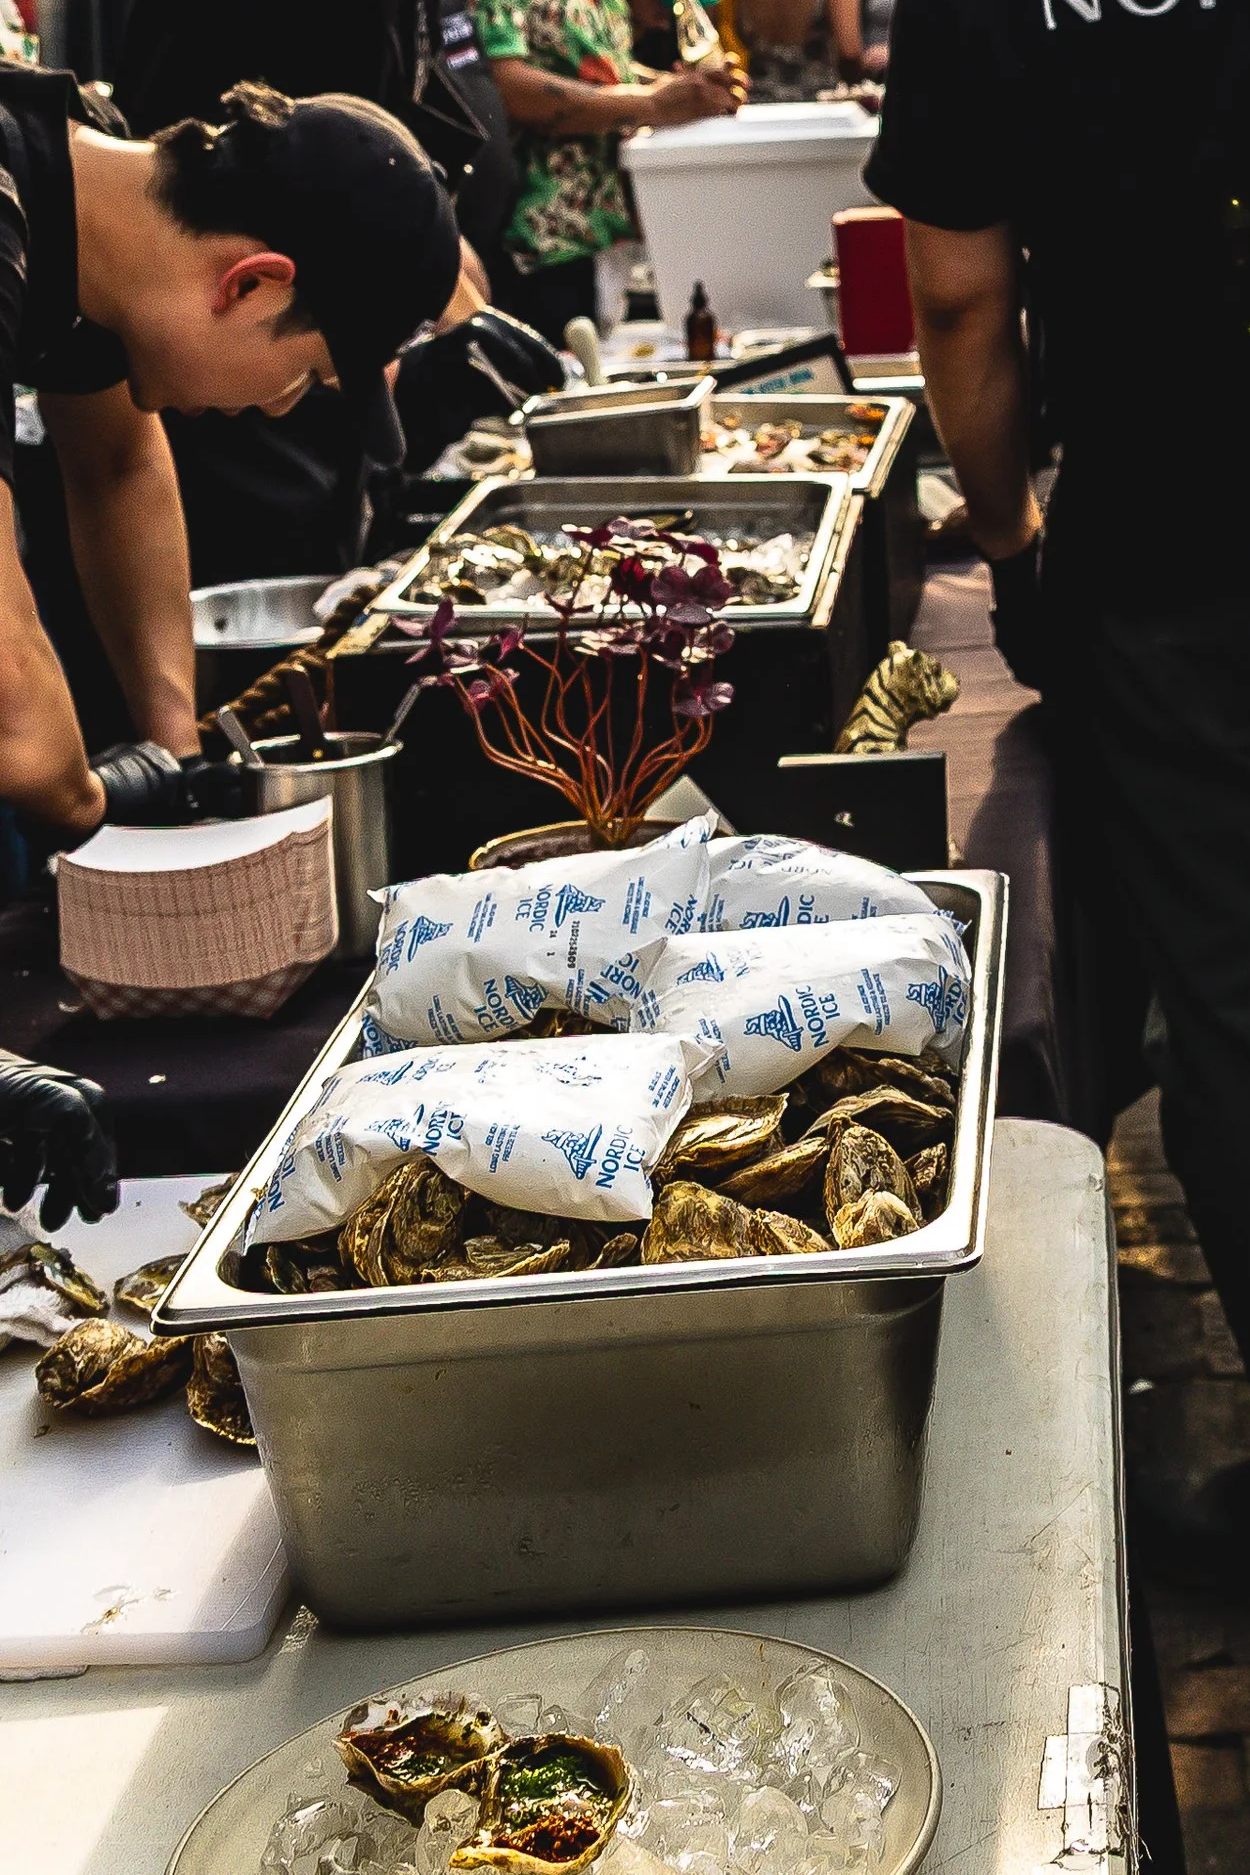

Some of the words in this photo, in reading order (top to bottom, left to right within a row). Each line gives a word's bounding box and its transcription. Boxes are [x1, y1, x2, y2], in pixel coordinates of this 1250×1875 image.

[515, 898, 534, 922] ICE
[664, 902, 683, 933] ICE
[797, 894, 815, 924] DIC
[618, 952, 639, 973] IC
[474, 1006, 499, 1033] ICE
[796, 985, 829, 1048] NORDIC
[819, 993, 840, 1020] ICE
[595, 1124, 633, 1189] NORDIC
[623, 1143, 646, 1172] ICE
